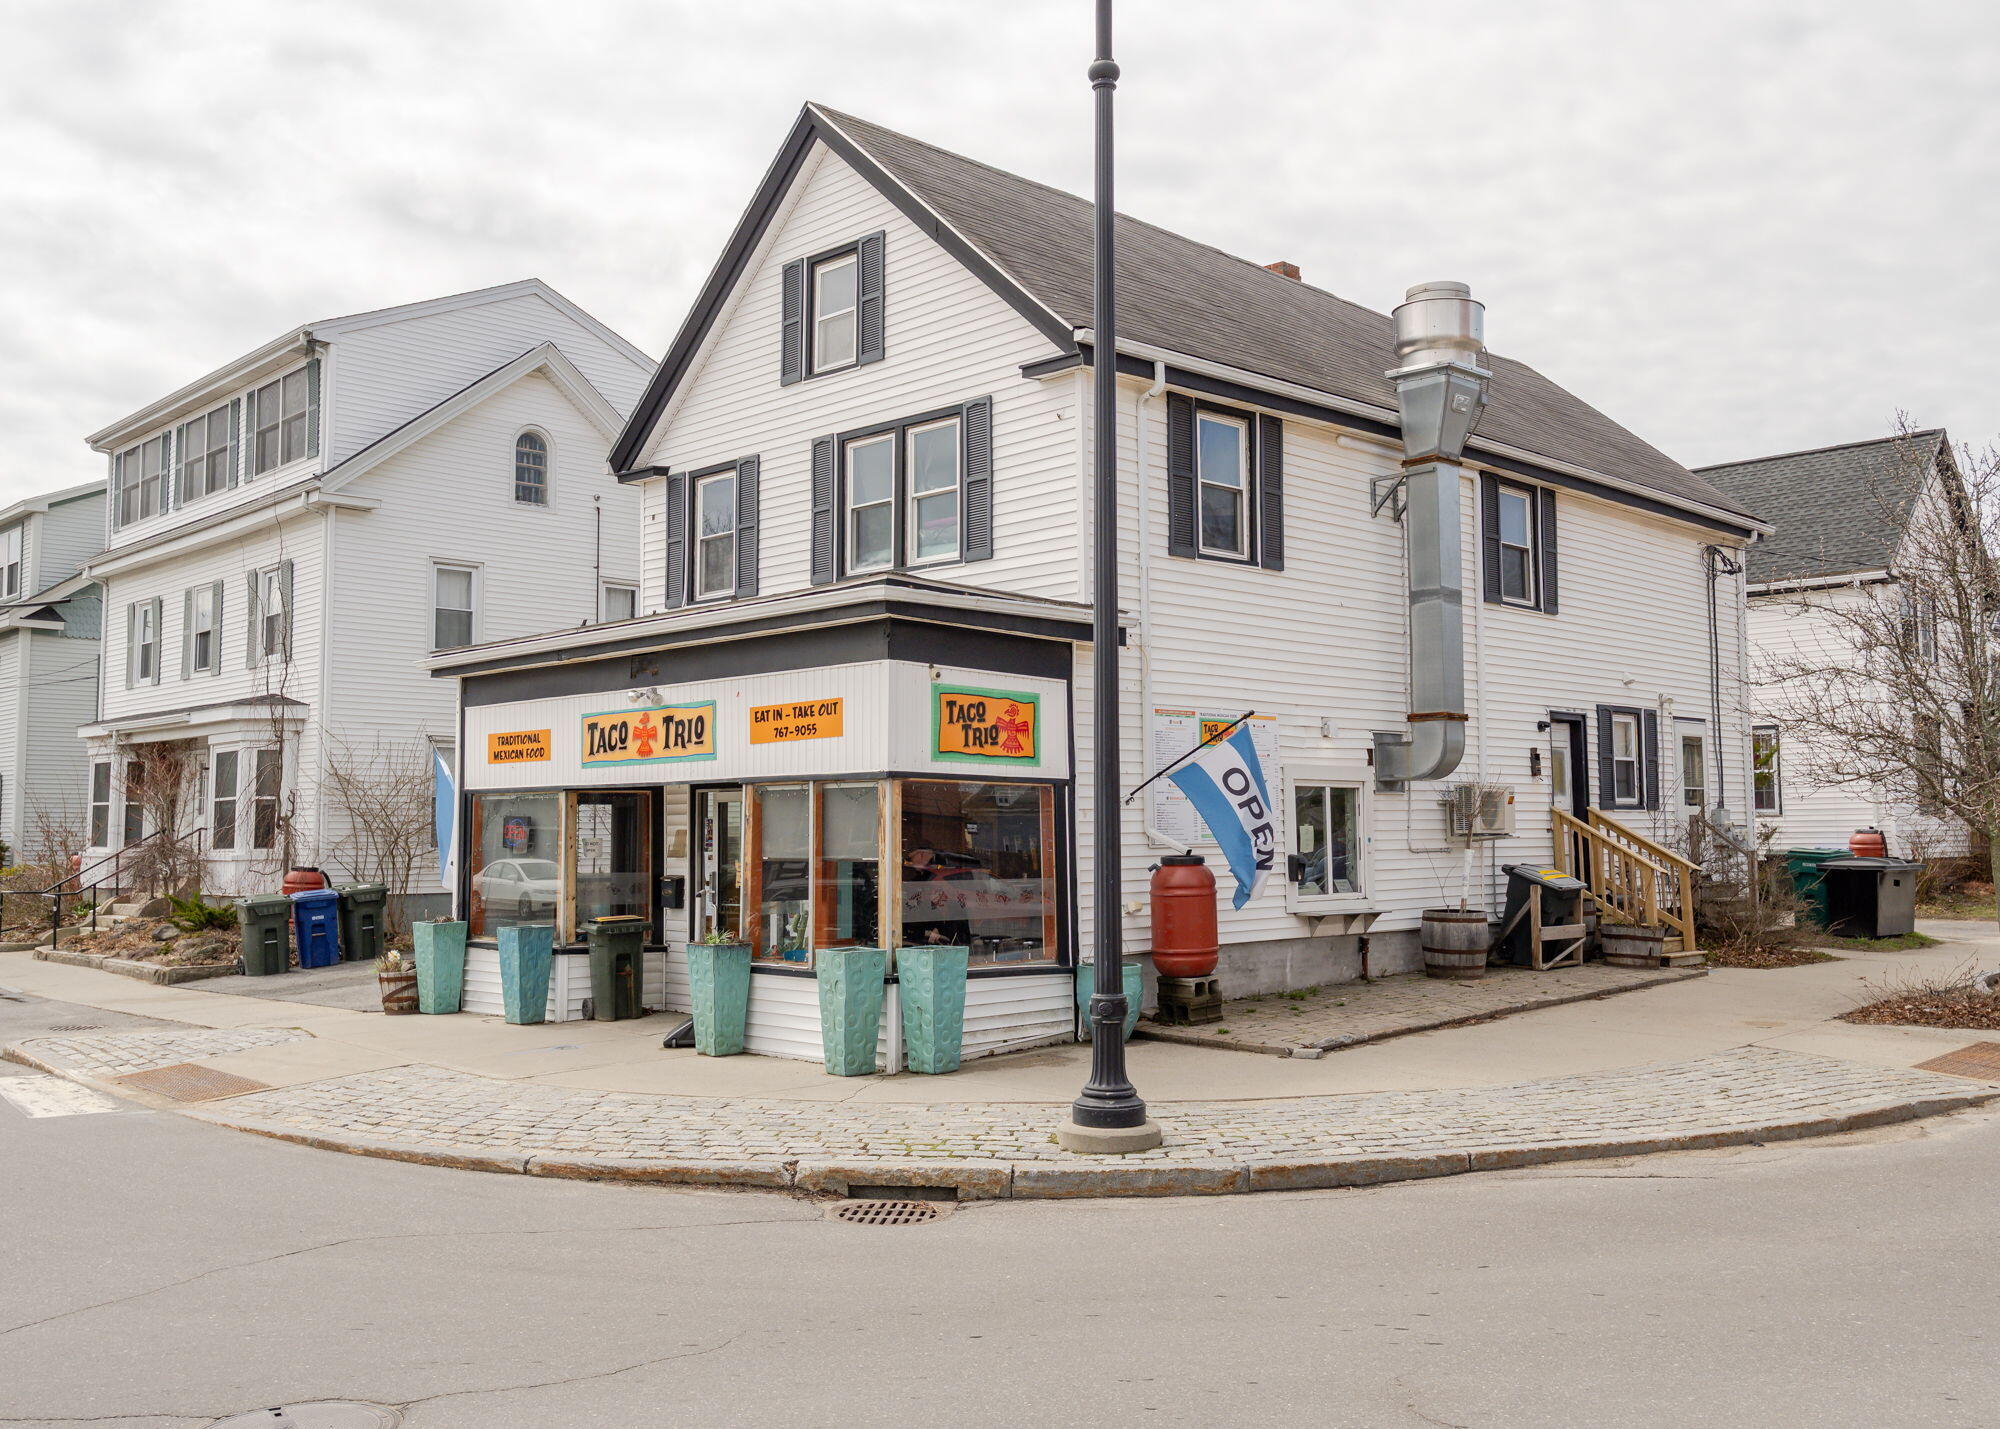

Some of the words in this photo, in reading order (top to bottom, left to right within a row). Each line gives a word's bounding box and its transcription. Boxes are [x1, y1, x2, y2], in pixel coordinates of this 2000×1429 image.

[754, 709, 771, 723] EAT
[773, 708, 783, 721] IN
[792, 704, 816, 719] TAKE
[818, 701, 839, 716] OUT
[946, 700, 986, 724] TACO
[588, 720, 629, 756] TACO
[662, 714, 705, 750] TRIO
[773, 723, 818, 738] 767-9055
[961, 723, 1000, 748] TRIO
[1204, 723, 1219, 734] TACO
[497, 733, 541, 746] TRADITIONAL
[493, 749, 524, 761] MEXICAN
[525, 747, 545, 759] FOOD
[1222, 767, 1274, 871] OPEN
[504, 825, 527, 840] OPEN
